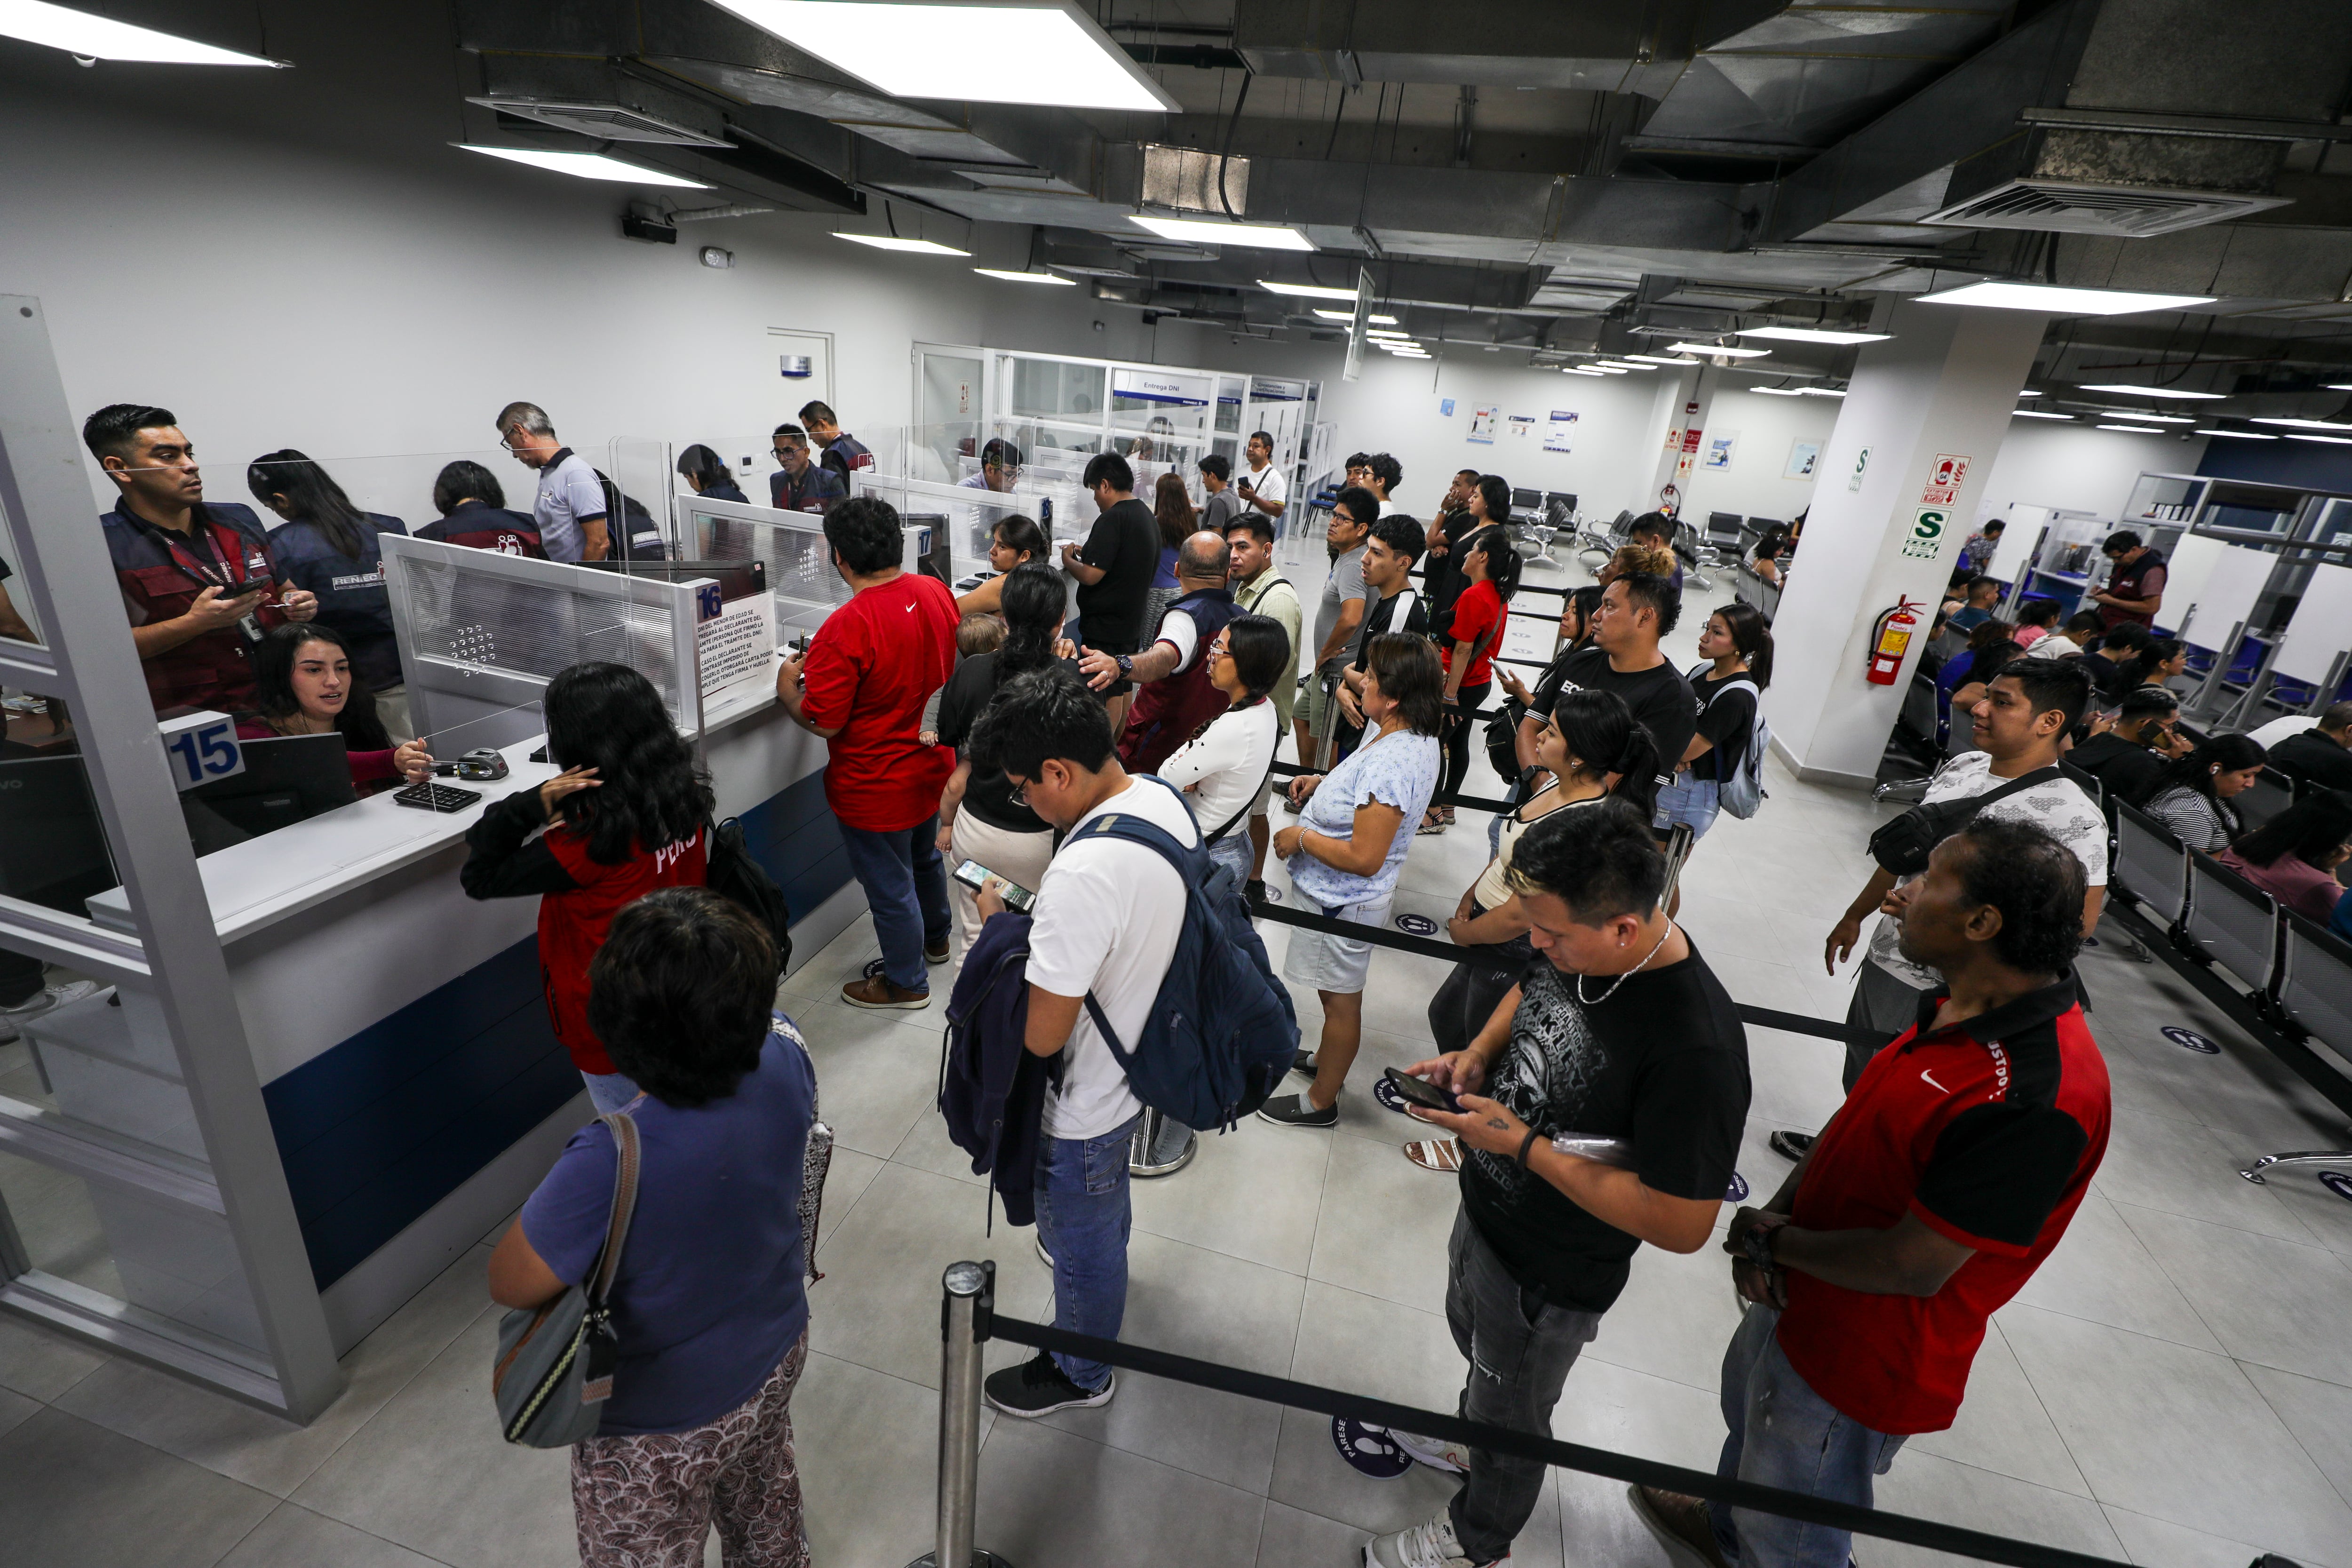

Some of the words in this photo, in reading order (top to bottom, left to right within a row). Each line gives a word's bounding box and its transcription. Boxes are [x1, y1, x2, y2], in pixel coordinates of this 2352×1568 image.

[1144, 382, 1167, 391] Entrega
[1856, 449, 1868, 473] S
[1042, 499, 1049, 517] 18
[1915, 512, 1943, 538] S
[633, 532, 658, 543] RENIEC
[919, 530, 931, 554] 17
[201, 566, 224, 584] RENIEC
[220, 562, 233, 583] RENIEC
[334, 574, 377, 585] RENIEC
[698, 585, 722, 619] 16
[712, 630, 733, 644] (PERSONA
[743, 623, 757, 631] FIRMÓ
[714, 618, 729, 628] MENOR
[724, 618, 753, 631] DECLARANTE
[724, 636, 743, 645] TRÁMITE
[701, 657, 712, 666] CASO
[718, 645, 746, 659] DECLARANTE
[701, 662, 723, 674] CONTRASE
[723, 653, 743, 664] IMPEDIDO
[722, 660, 744, 673] OTORGARÁ
[760, 650, 773, 659] PODER
[720, 672, 734, 681] TENGA
[735, 666, 748, 675] FIRMA
[753, 659, 771, 668] HUELLA.
[170, 724, 238, 782] 15
[1543, 993, 1557, 1007] ECO
[1556, 1006, 1584, 1053] COALITION
[1380, 1080, 1391, 1089] AQU
[1995, 1067, 2009, 1087] DO
[1733, 1175, 1744, 1194] RENIEC
